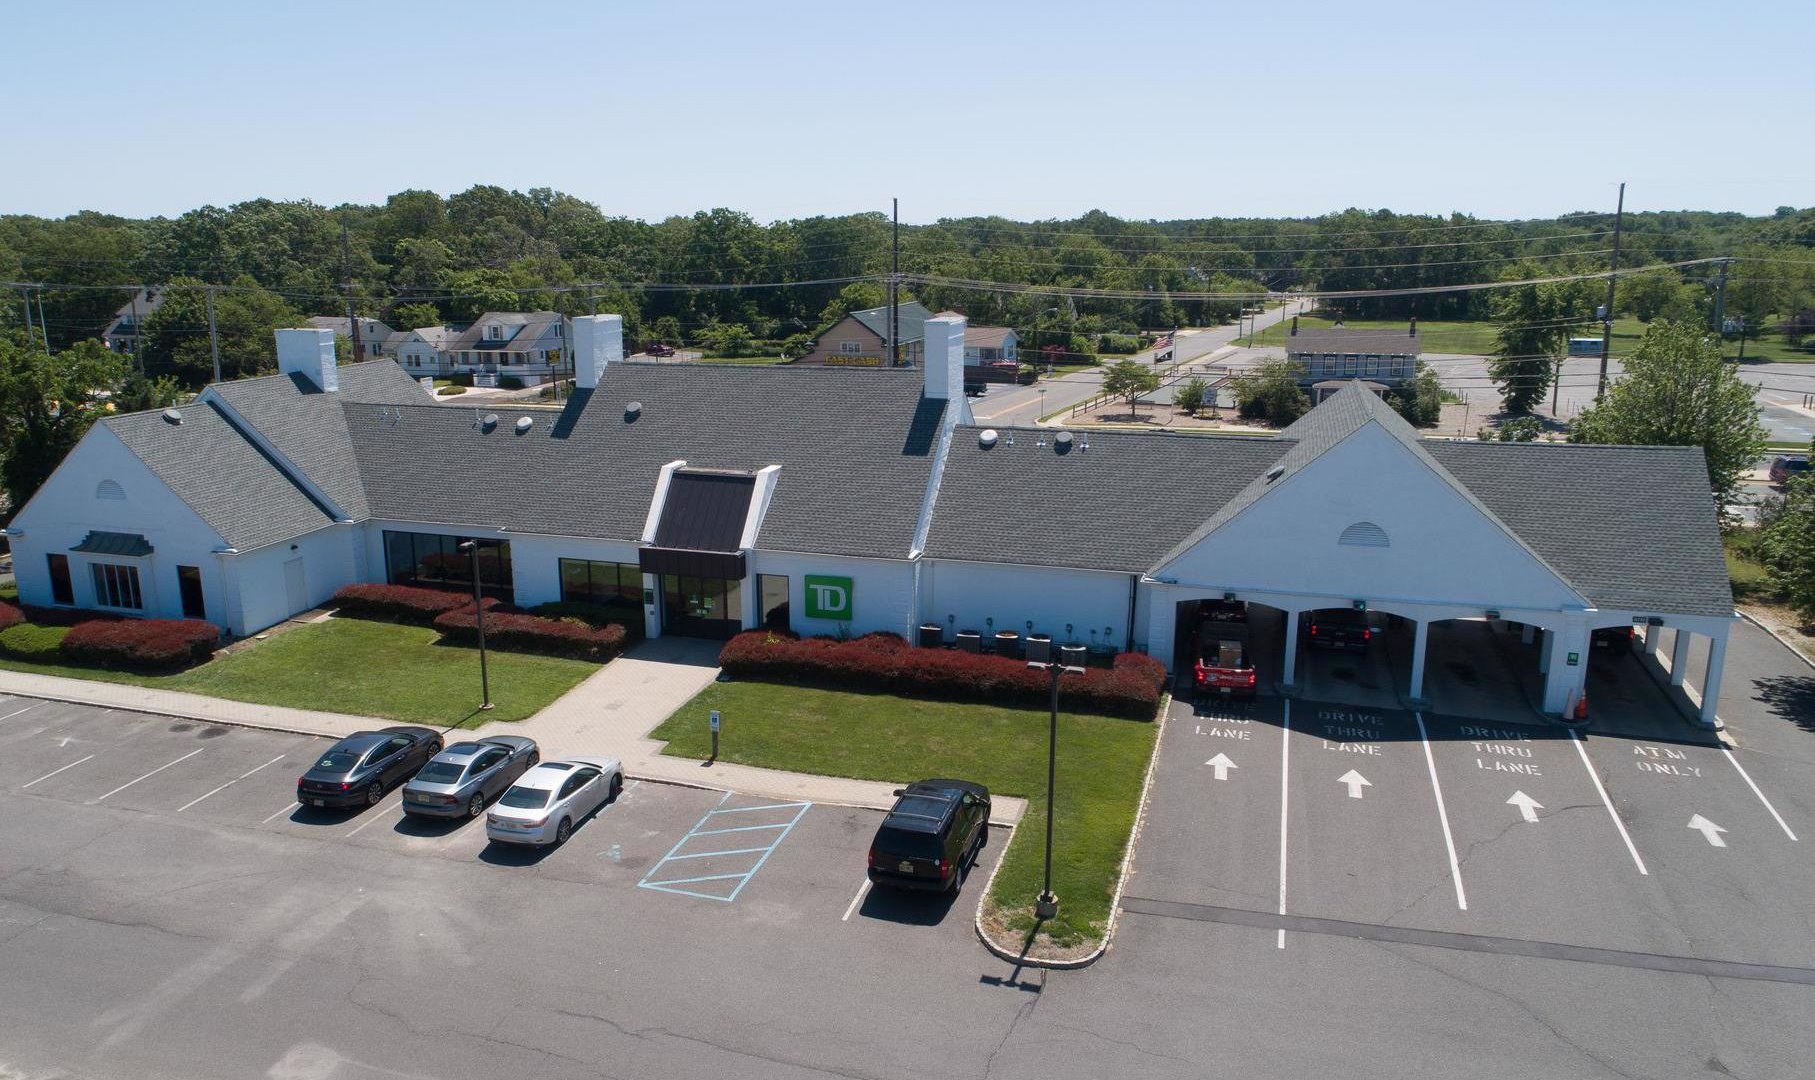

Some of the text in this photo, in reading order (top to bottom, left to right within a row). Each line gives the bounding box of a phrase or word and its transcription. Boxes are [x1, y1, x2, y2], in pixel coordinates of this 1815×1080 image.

[809, 584, 847, 611] TD
[1319, 711, 1384, 726] DRIVE
[1195, 725, 1251, 741] LANE
[1324, 725, 1381, 740] THRU
[1460, 726, 1532, 742] DRIVE
[1323, 740, 1382, 756] LANE
[1470, 741, 1532, 758] THRU
[1633, 745, 1687, 760] ATM
[1477, 758, 1542, 776] LANE
[1636, 762, 1702, 778] ONLY
